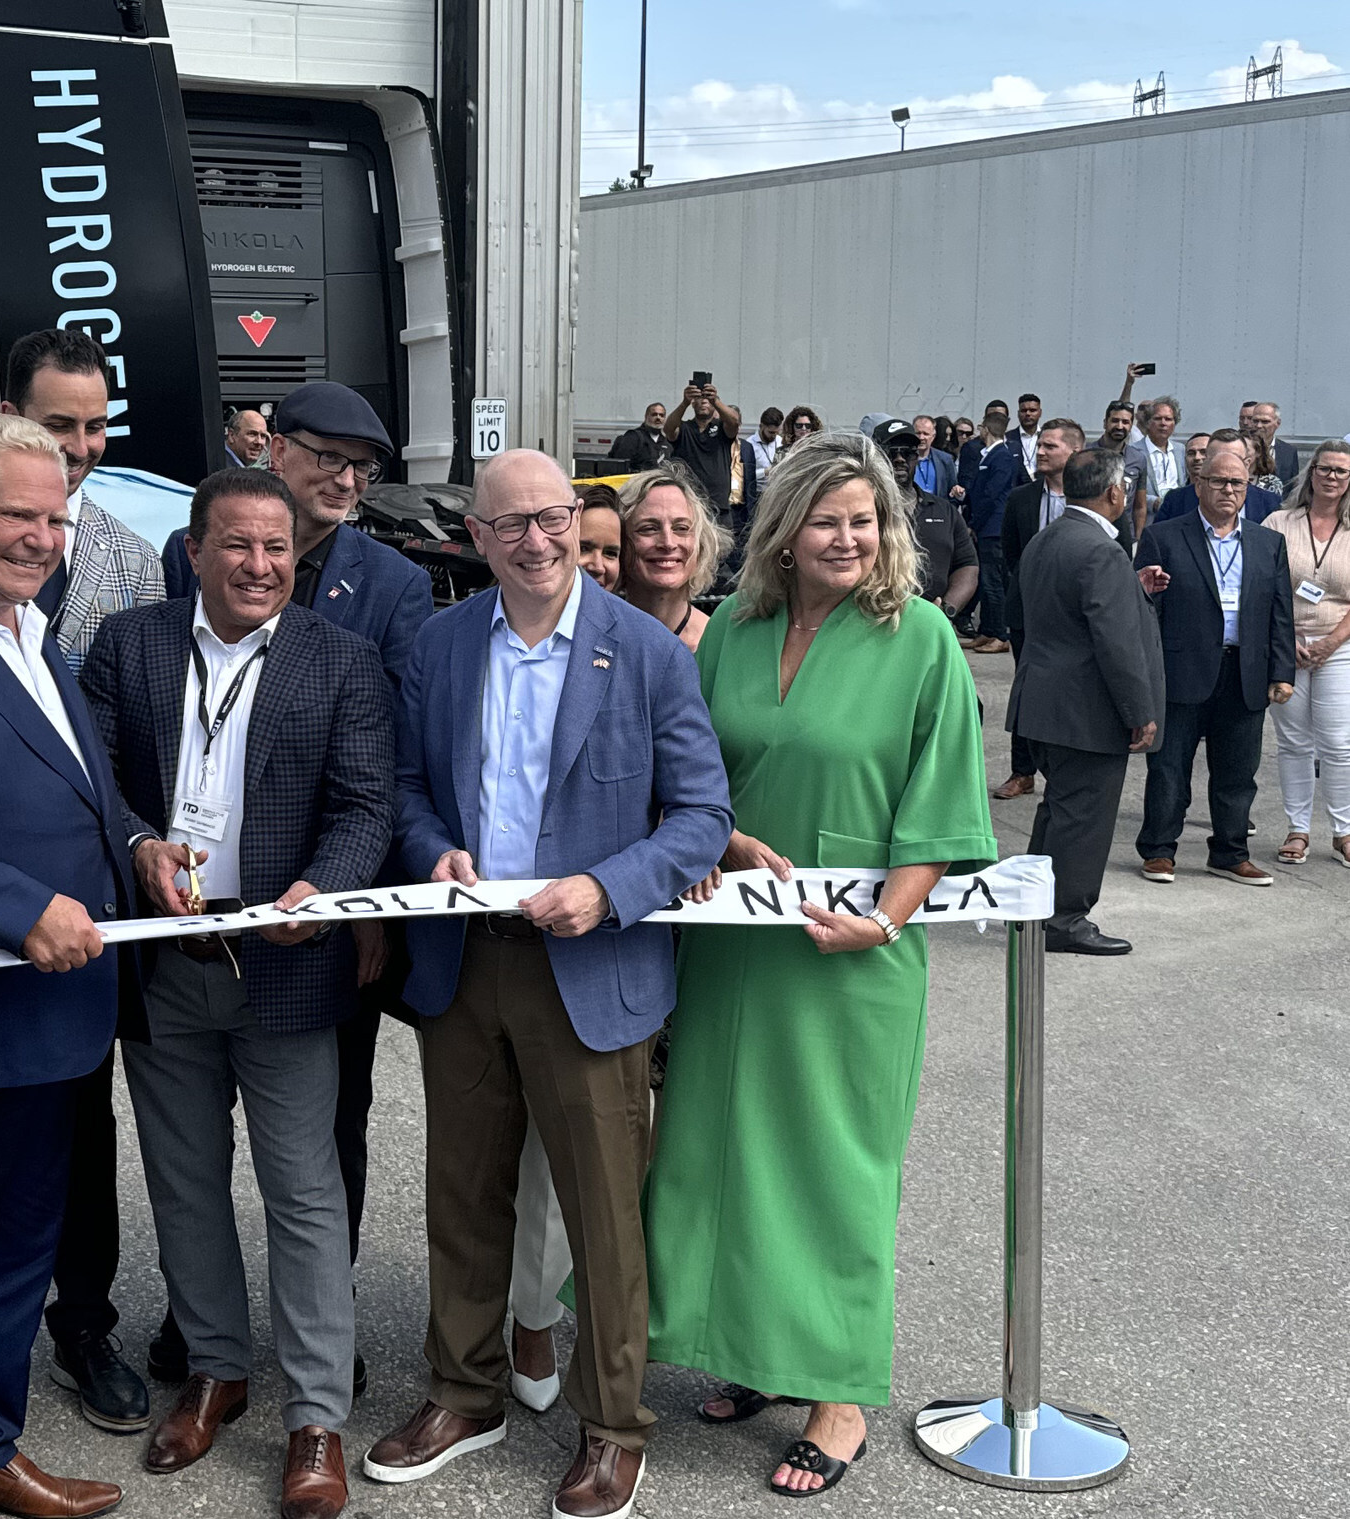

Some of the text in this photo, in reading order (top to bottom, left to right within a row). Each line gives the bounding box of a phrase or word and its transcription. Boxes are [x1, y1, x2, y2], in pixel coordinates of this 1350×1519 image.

[202, 231, 304, 250] NIKOLA
[211, 263, 296, 274] HYDROGEN ELECTRIC
[475, 405, 505, 414] SPEED
[478, 417, 501, 427] LIMIT
[479, 430, 500, 452] 10
[182, 802, 199, 814] ITD
